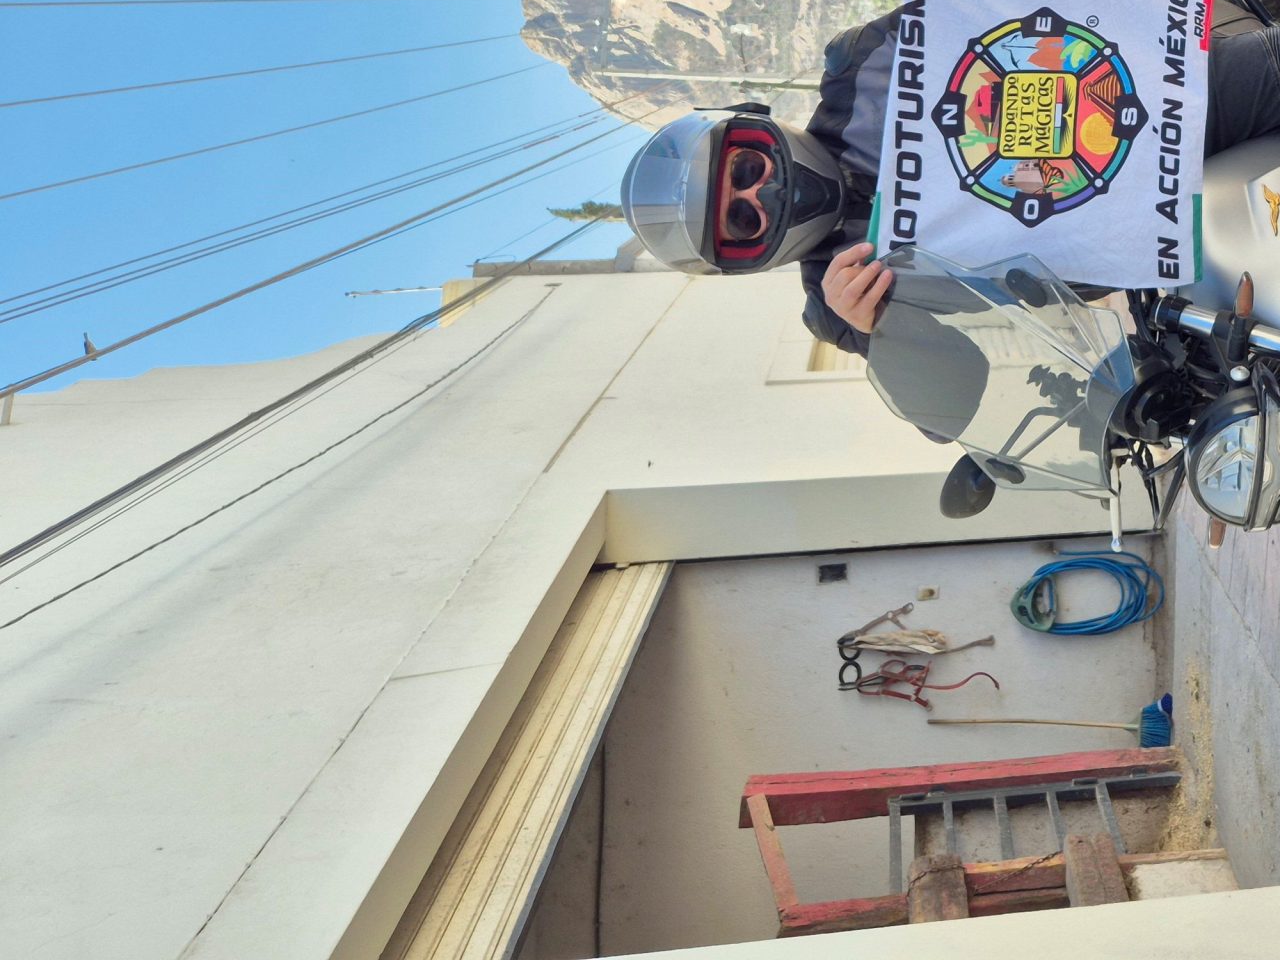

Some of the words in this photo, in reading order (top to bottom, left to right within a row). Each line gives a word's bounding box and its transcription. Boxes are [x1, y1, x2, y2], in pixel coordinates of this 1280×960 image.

[1035, 17, 1051, 33] E
[1194, 2, 1206, 38] RRM
[941, 104, 958, 125] N
[1122, 107, 1138, 125] S
[1152, 98, 1183, 224] ACCIÓN
[1024, 198, 1038, 220] O
[1157, 237, 1179, 279] EN
